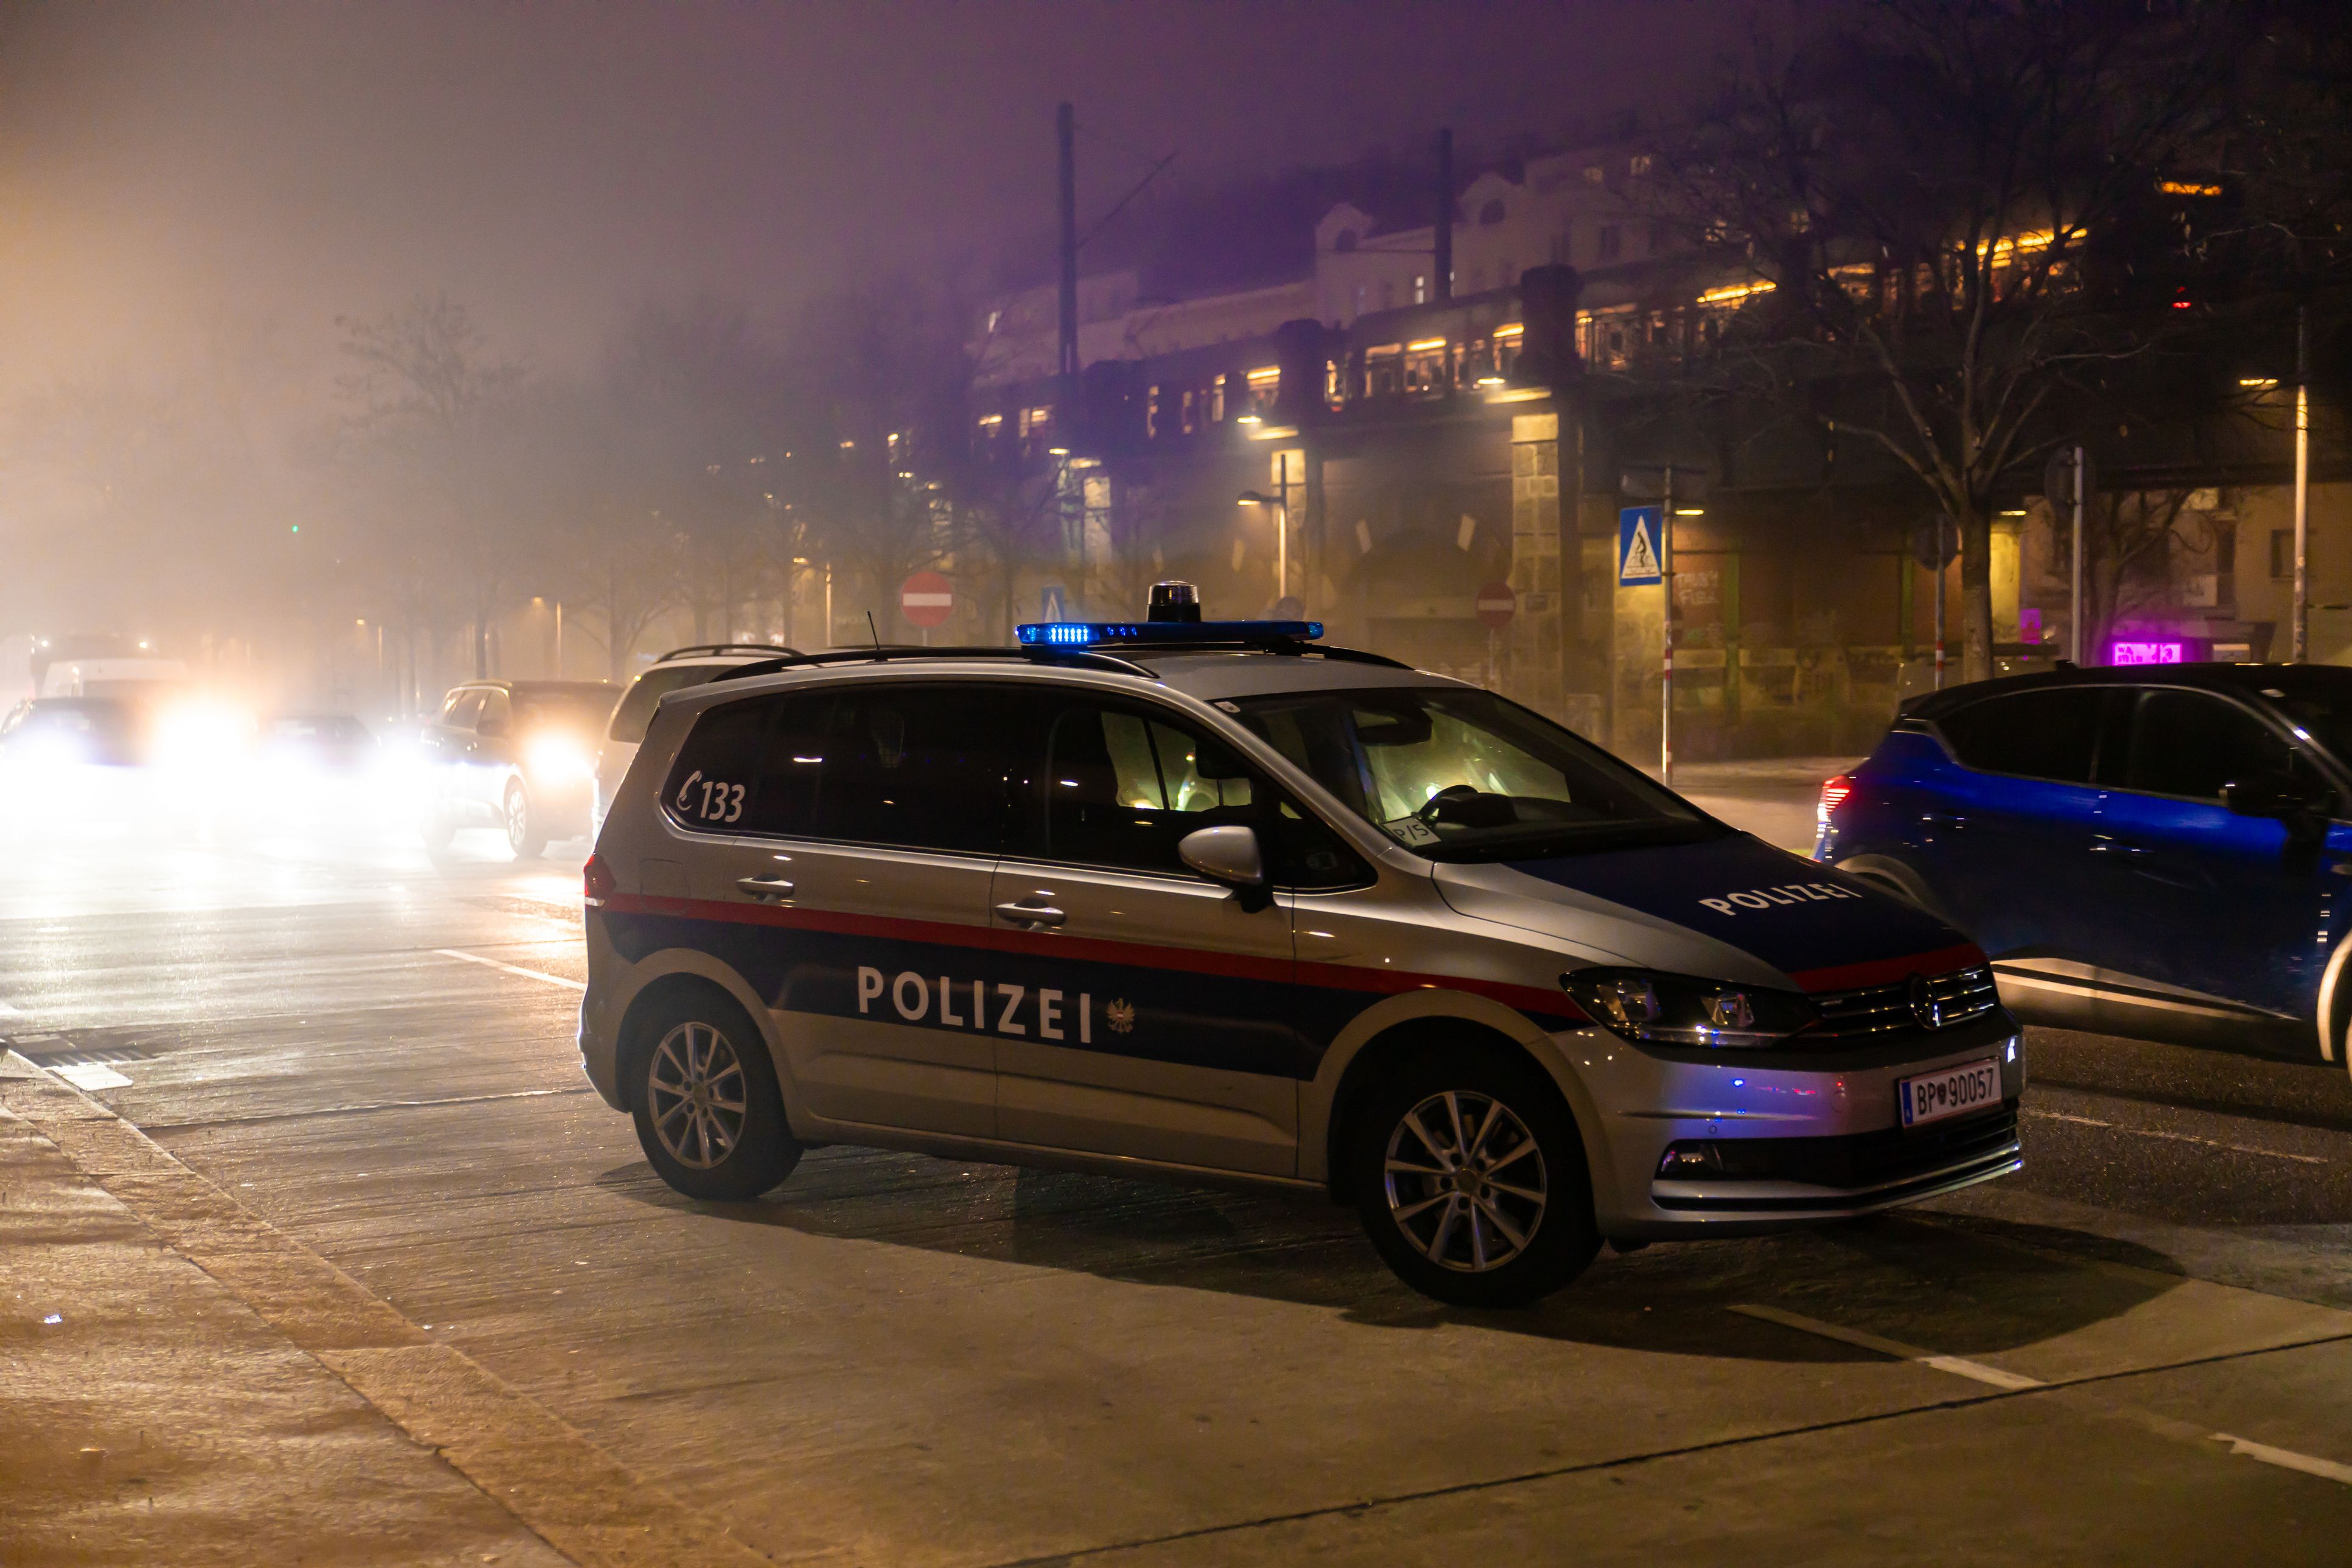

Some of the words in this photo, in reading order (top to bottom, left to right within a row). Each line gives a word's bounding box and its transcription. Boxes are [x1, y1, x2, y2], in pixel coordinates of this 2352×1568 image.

[700, 781, 746, 822] 133
[1697, 883, 1864, 916] POLIZEI
[857, 965, 1091, 1044] POLIZEI
